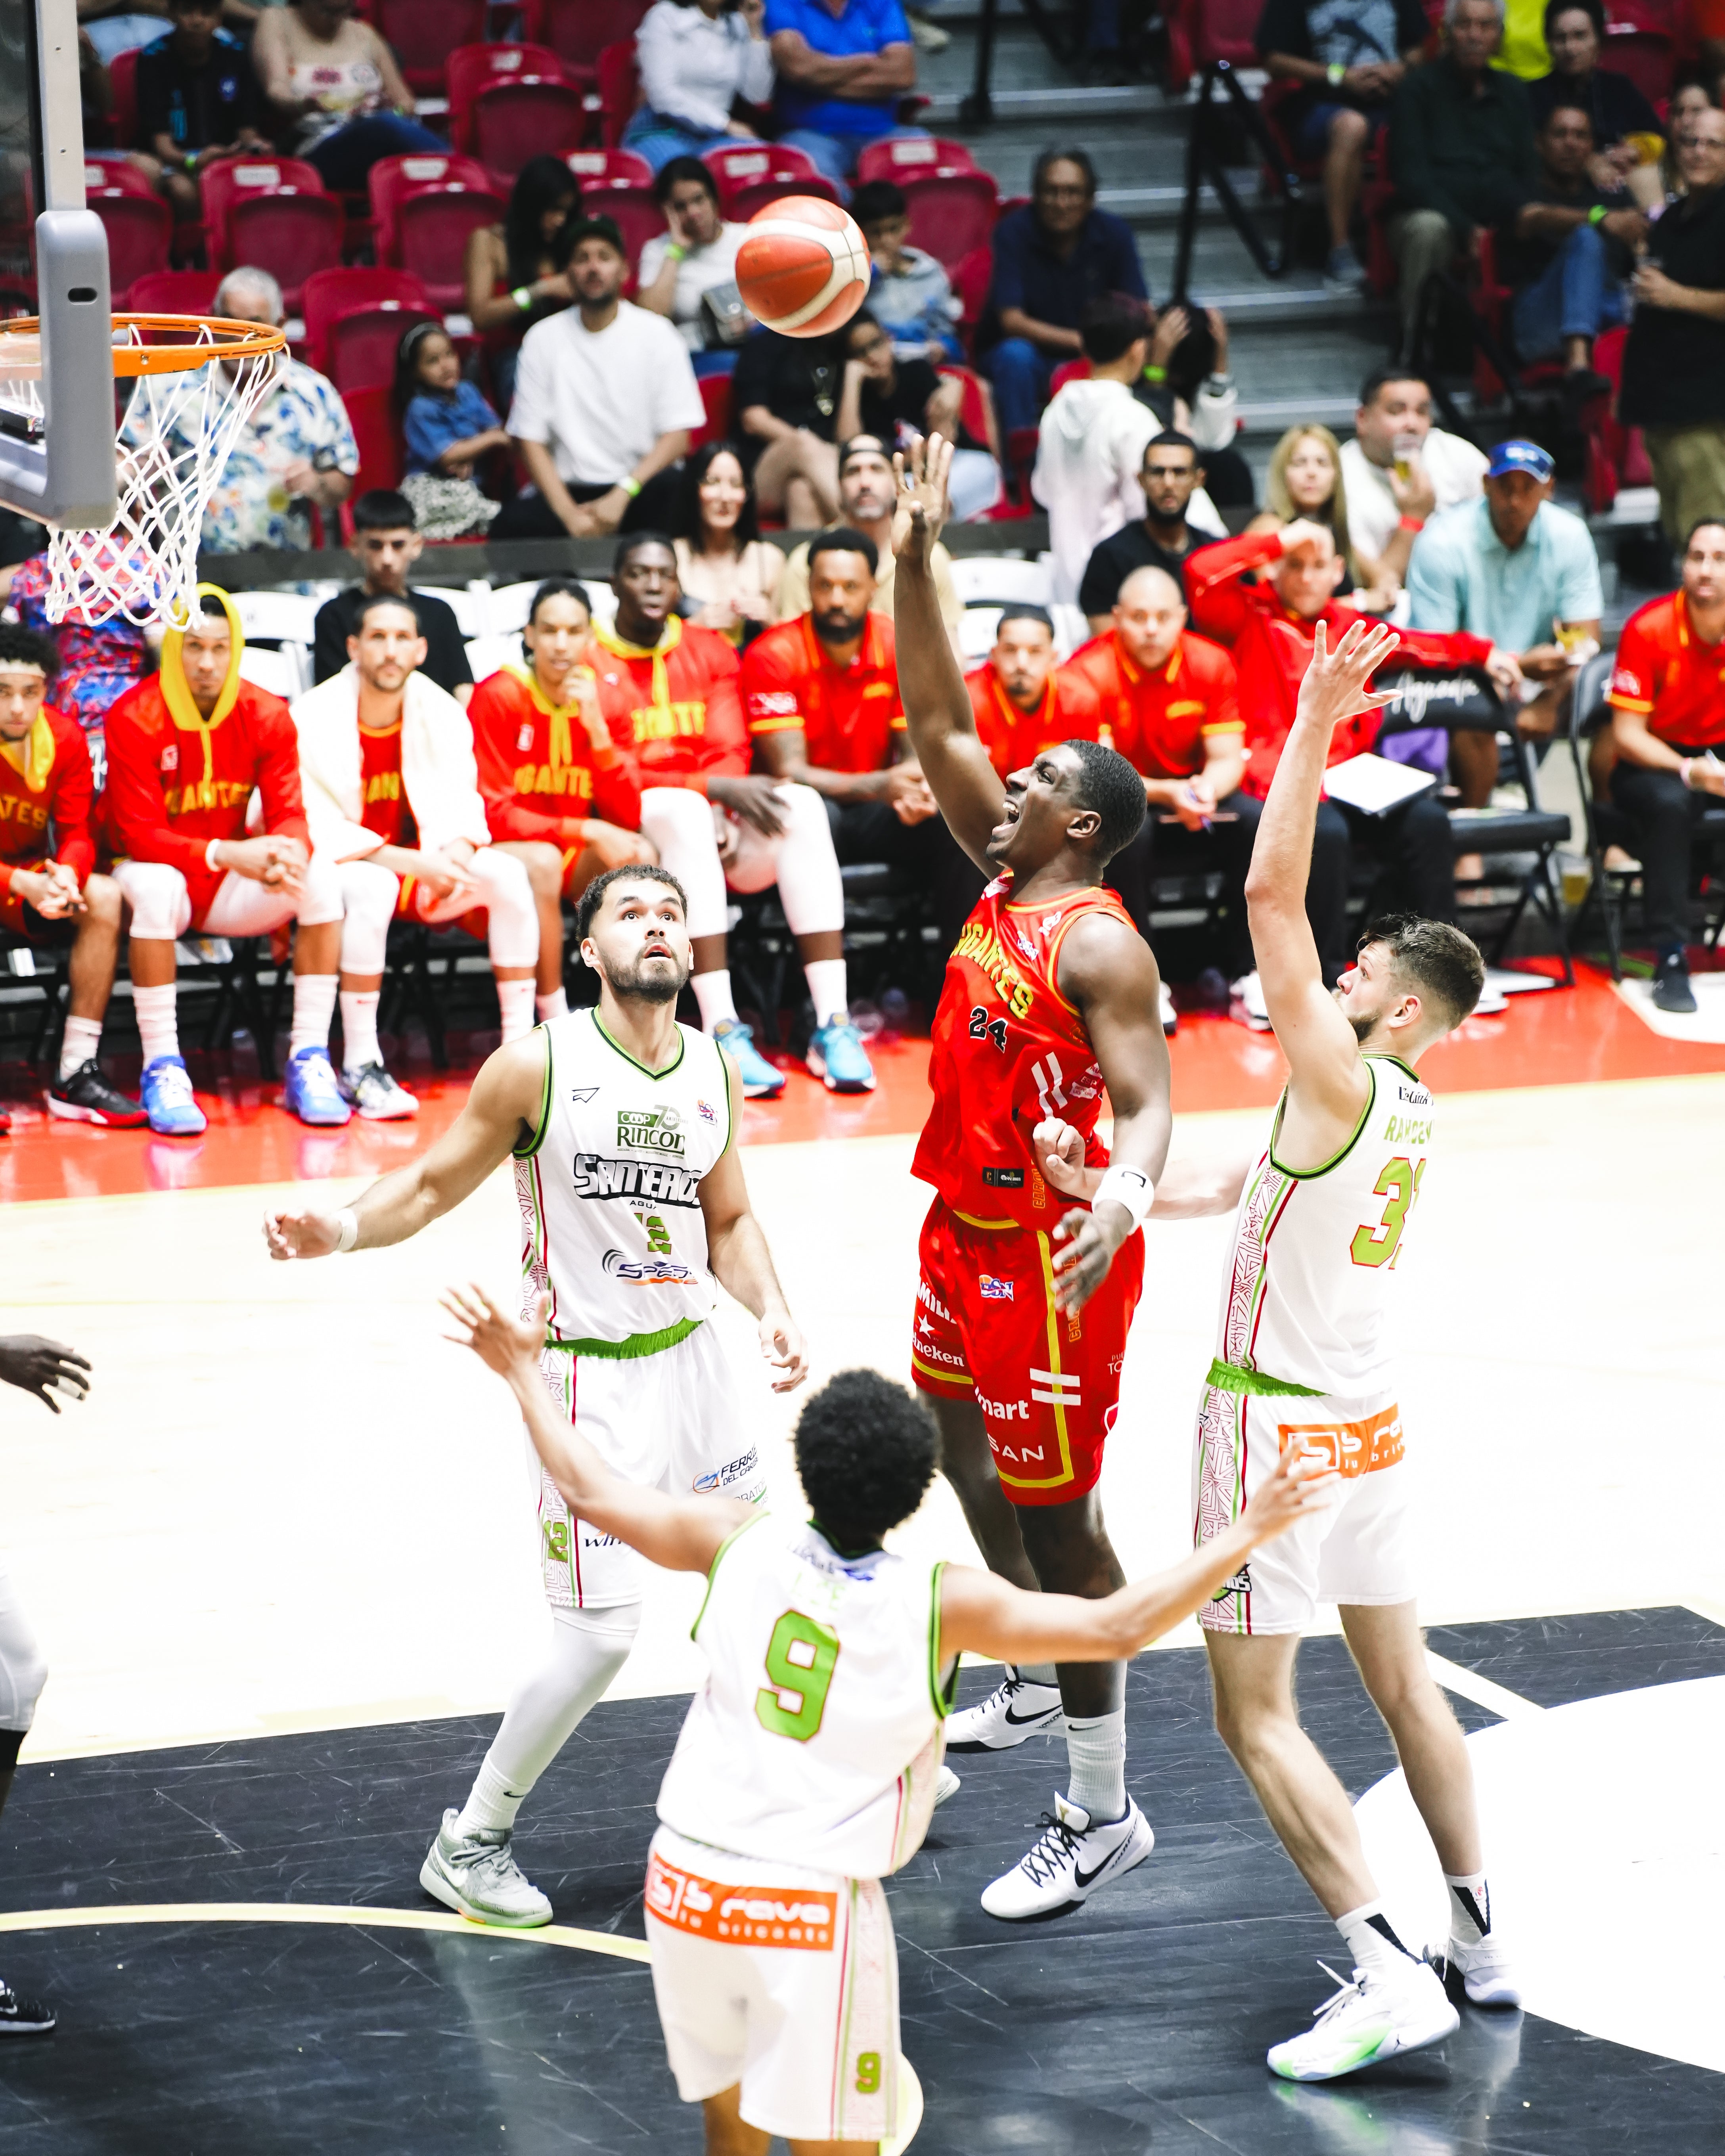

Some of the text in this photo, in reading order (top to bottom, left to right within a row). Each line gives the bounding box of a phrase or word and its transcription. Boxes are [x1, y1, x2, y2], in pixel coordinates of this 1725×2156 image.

[969, 1005, 1009, 1053] 24
[723, 1473, 739, 1486] DEL
[754, 1608, 840, 1743] 9
[856, 2051, 881, 2094] 9
